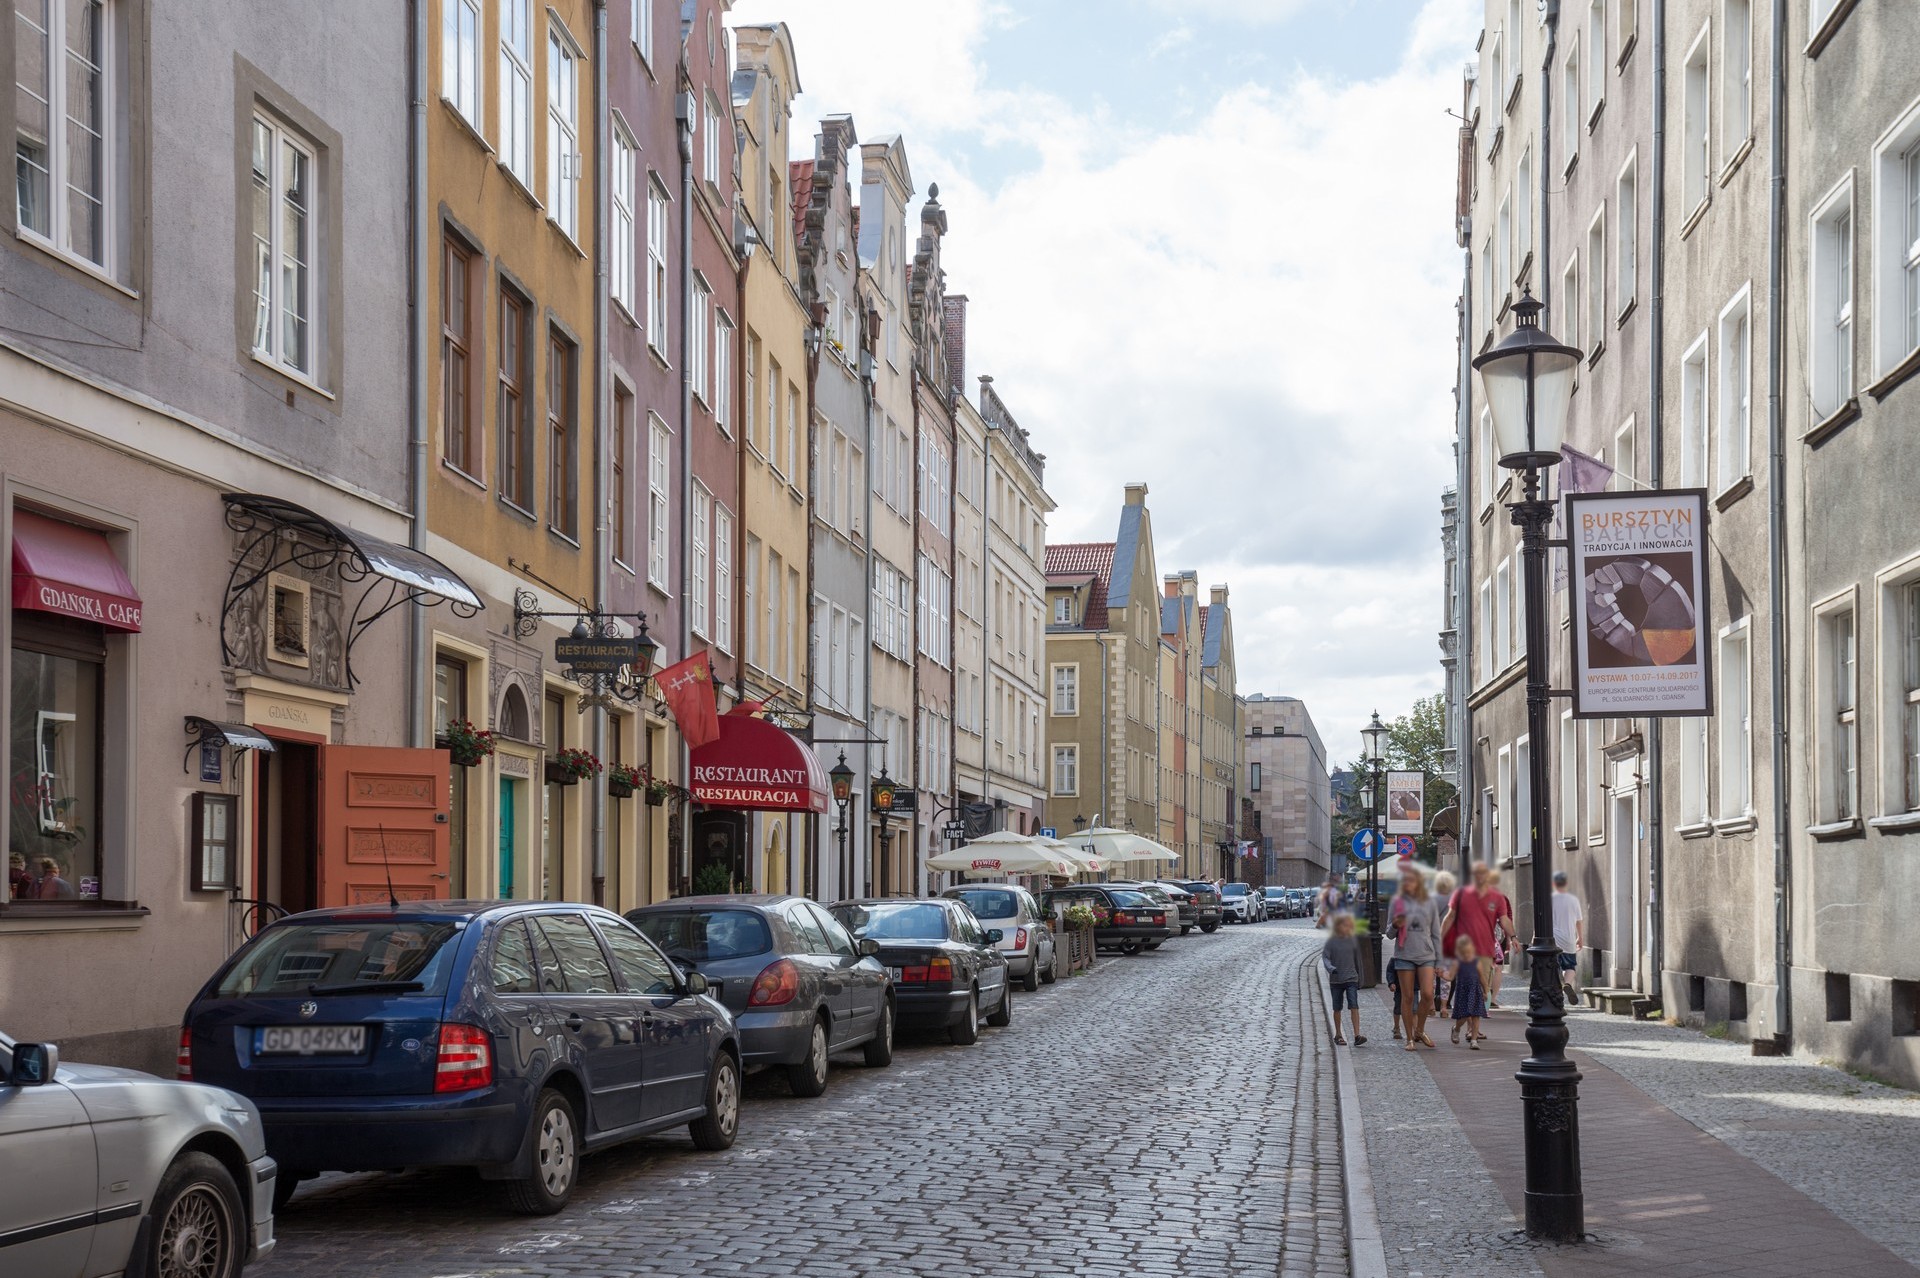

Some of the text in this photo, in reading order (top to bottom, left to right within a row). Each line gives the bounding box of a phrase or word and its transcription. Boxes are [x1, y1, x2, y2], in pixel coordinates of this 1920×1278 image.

[1582, 508, 1692, 530] BURSZTYN
[1583, 523, 1692, 543] BAŁTYCKI
[1583, 539, 1693, 553] TRADYCJA I INNOWACJA
[108, 603, 141, 626] CAFE
[557, 645, 635, 657] RESTAURACJA
[1587, 673, 1628, 683] WYSTAWA
[1587, 684, 1699, 695] EUROPEJSKIE CENTRUM SOLIDARNOŚCI
[693, 766, 806, 785] RESTAURANT
[695, 787, 799, 804] RESTAURACJA
